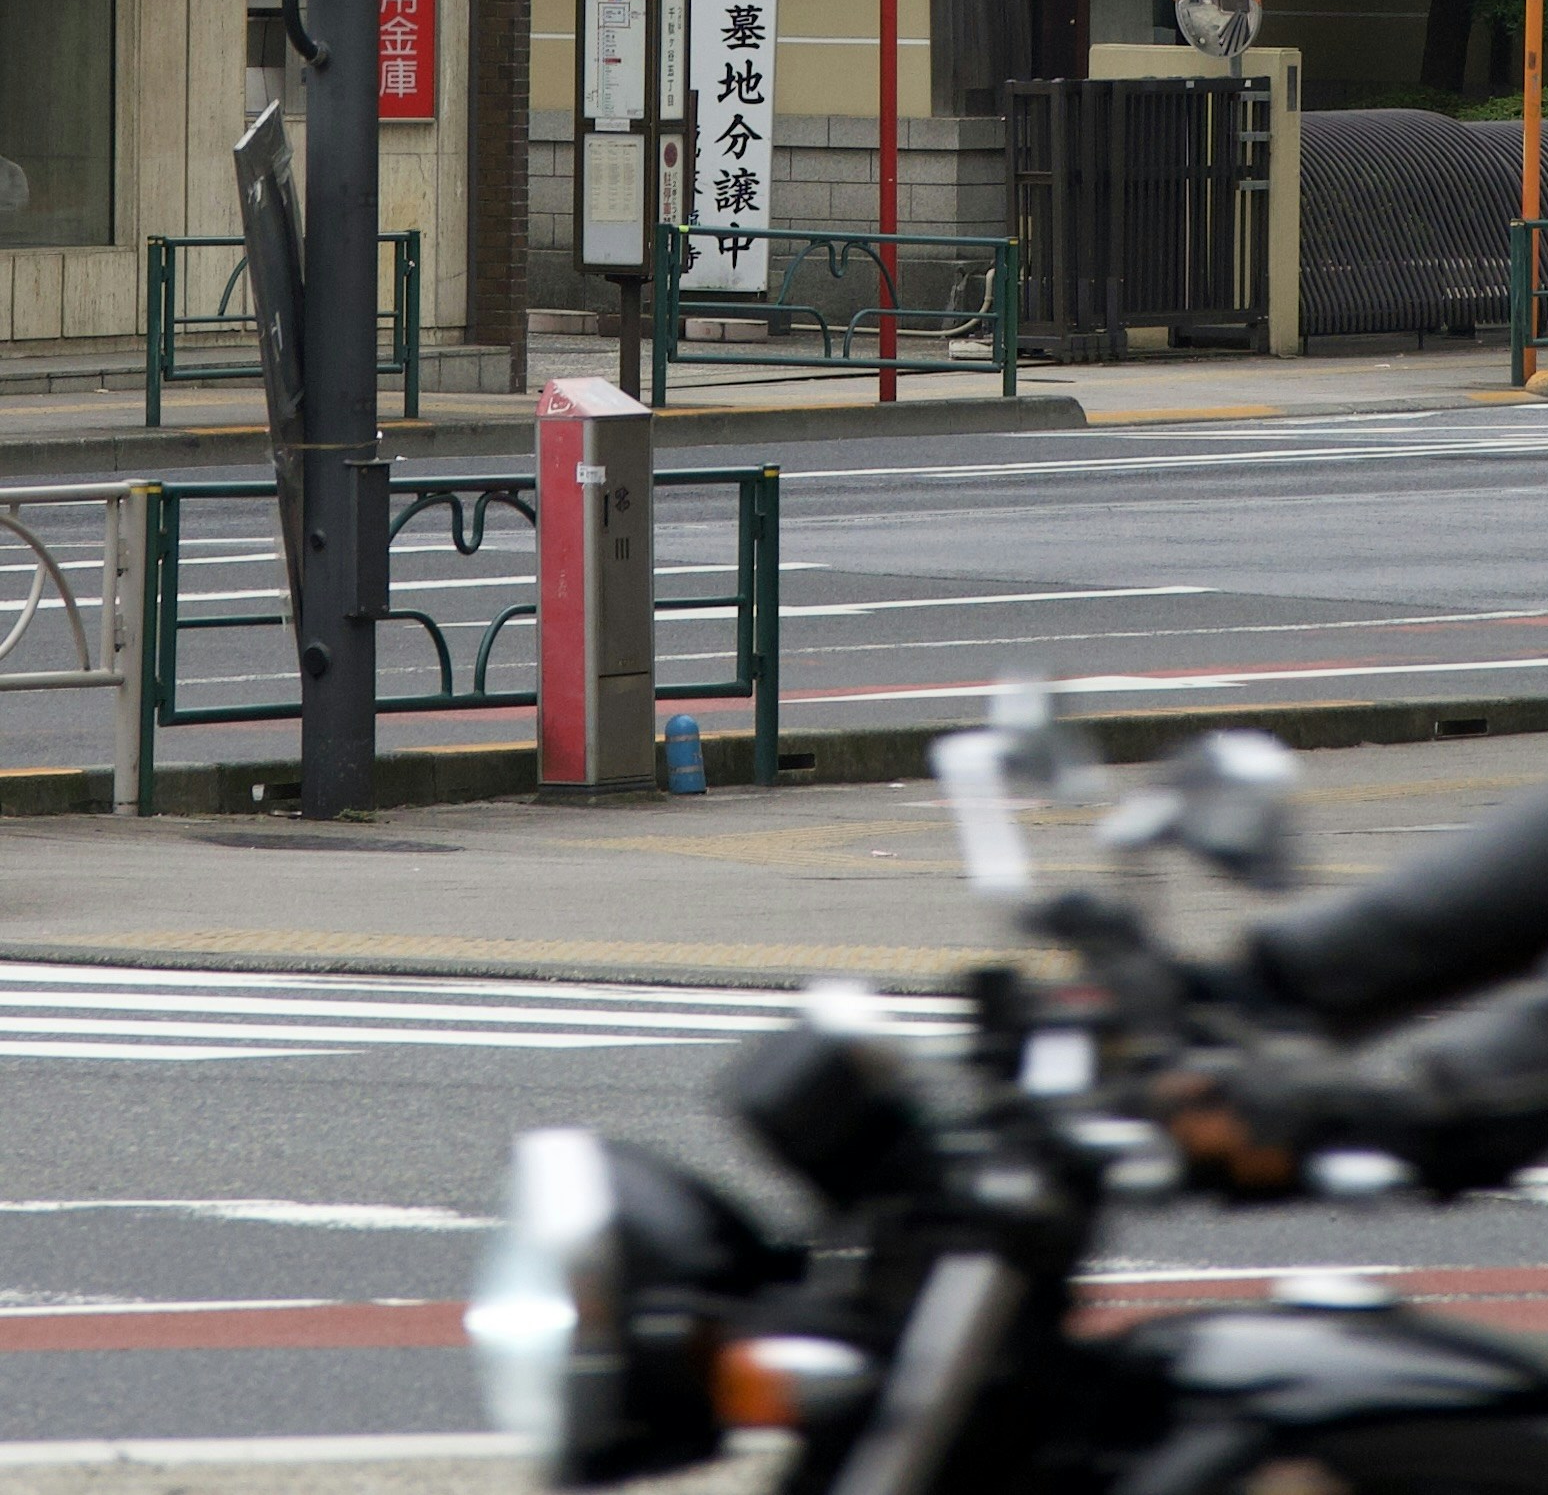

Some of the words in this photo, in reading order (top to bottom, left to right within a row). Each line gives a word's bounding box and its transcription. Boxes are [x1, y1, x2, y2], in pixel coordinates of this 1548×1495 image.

[714, 5, 766, 270] 墓地分譲中
